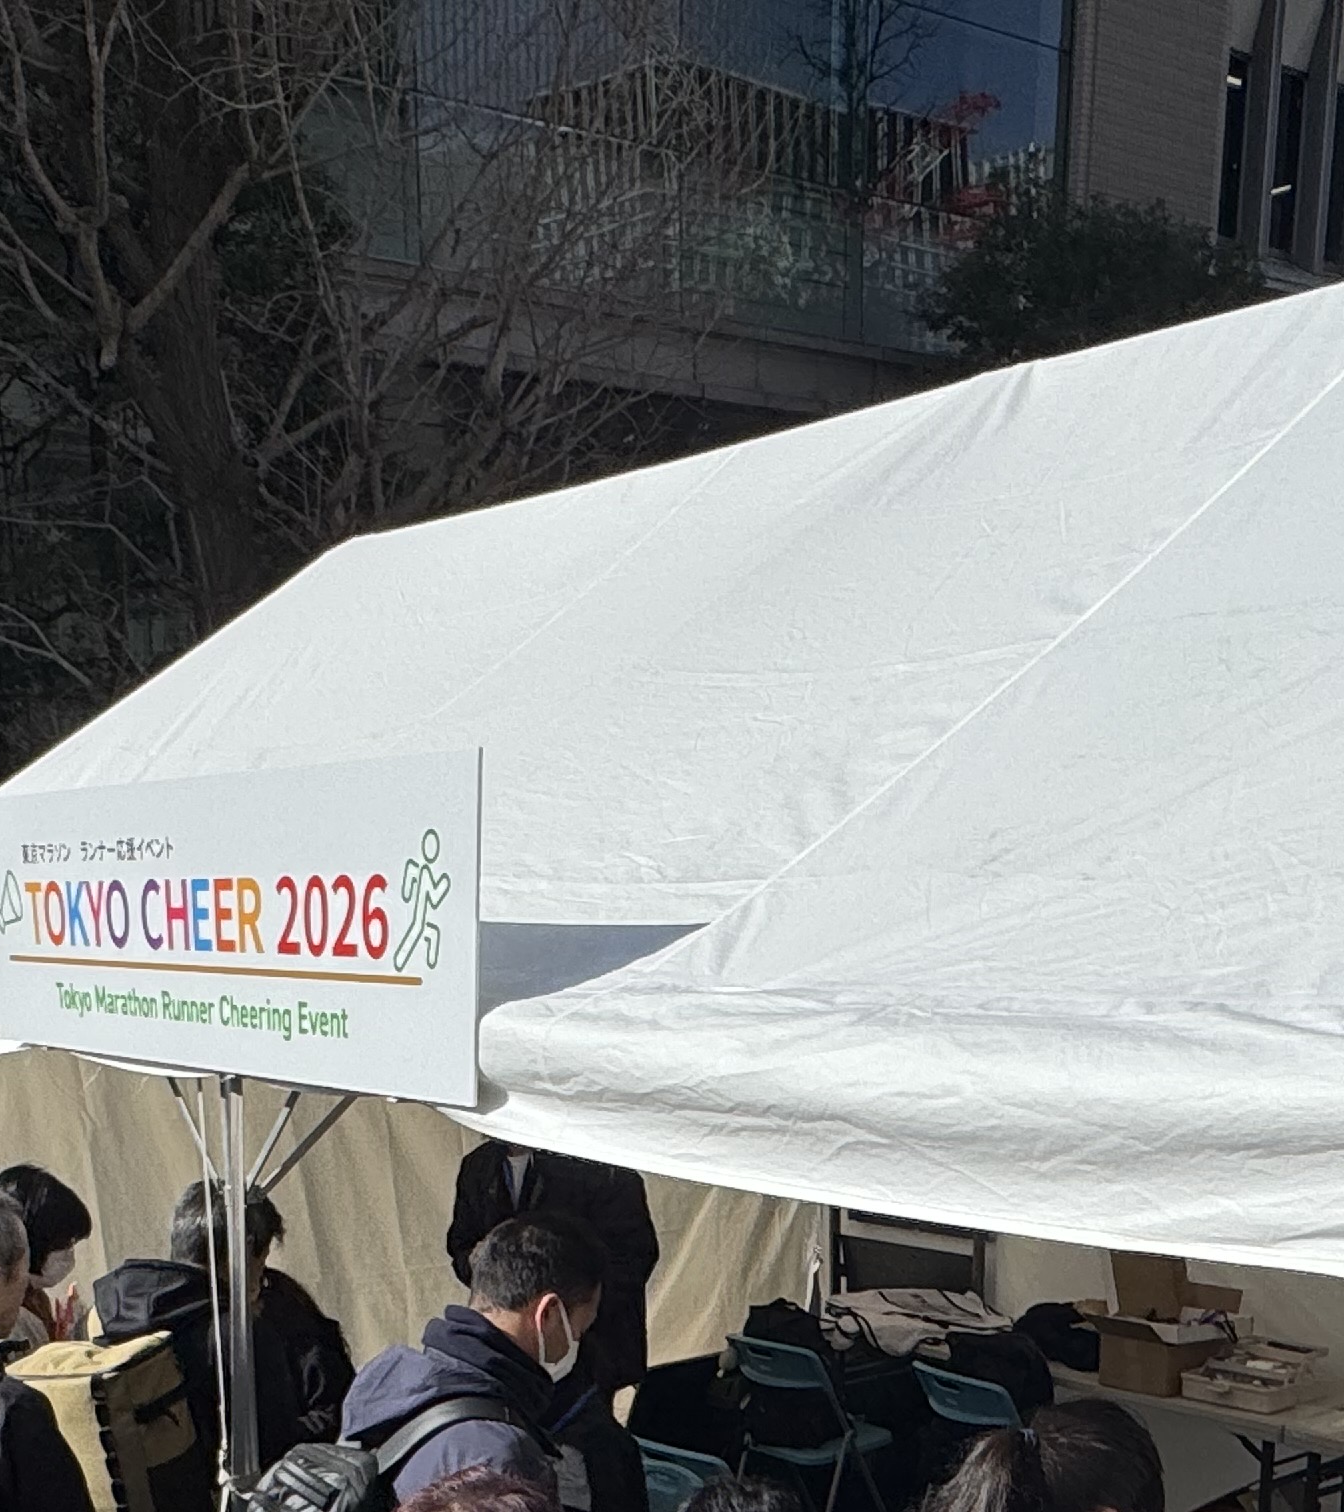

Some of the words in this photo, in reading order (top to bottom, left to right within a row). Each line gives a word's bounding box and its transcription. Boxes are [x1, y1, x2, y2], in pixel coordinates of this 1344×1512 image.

[25, 880, 130, 949] TOKYO
[141, 876, 265, 953] CHEER
[275, 873, 390, 959] 2026
[56, 982, 92, 1018] Tokyo
[94, 985, 159, 1019] Marathon
[161, 991, 216, 1024] Runner
[219, 995, 293, 1041] Cheering
[297, 1001, 349, 1039] Event
